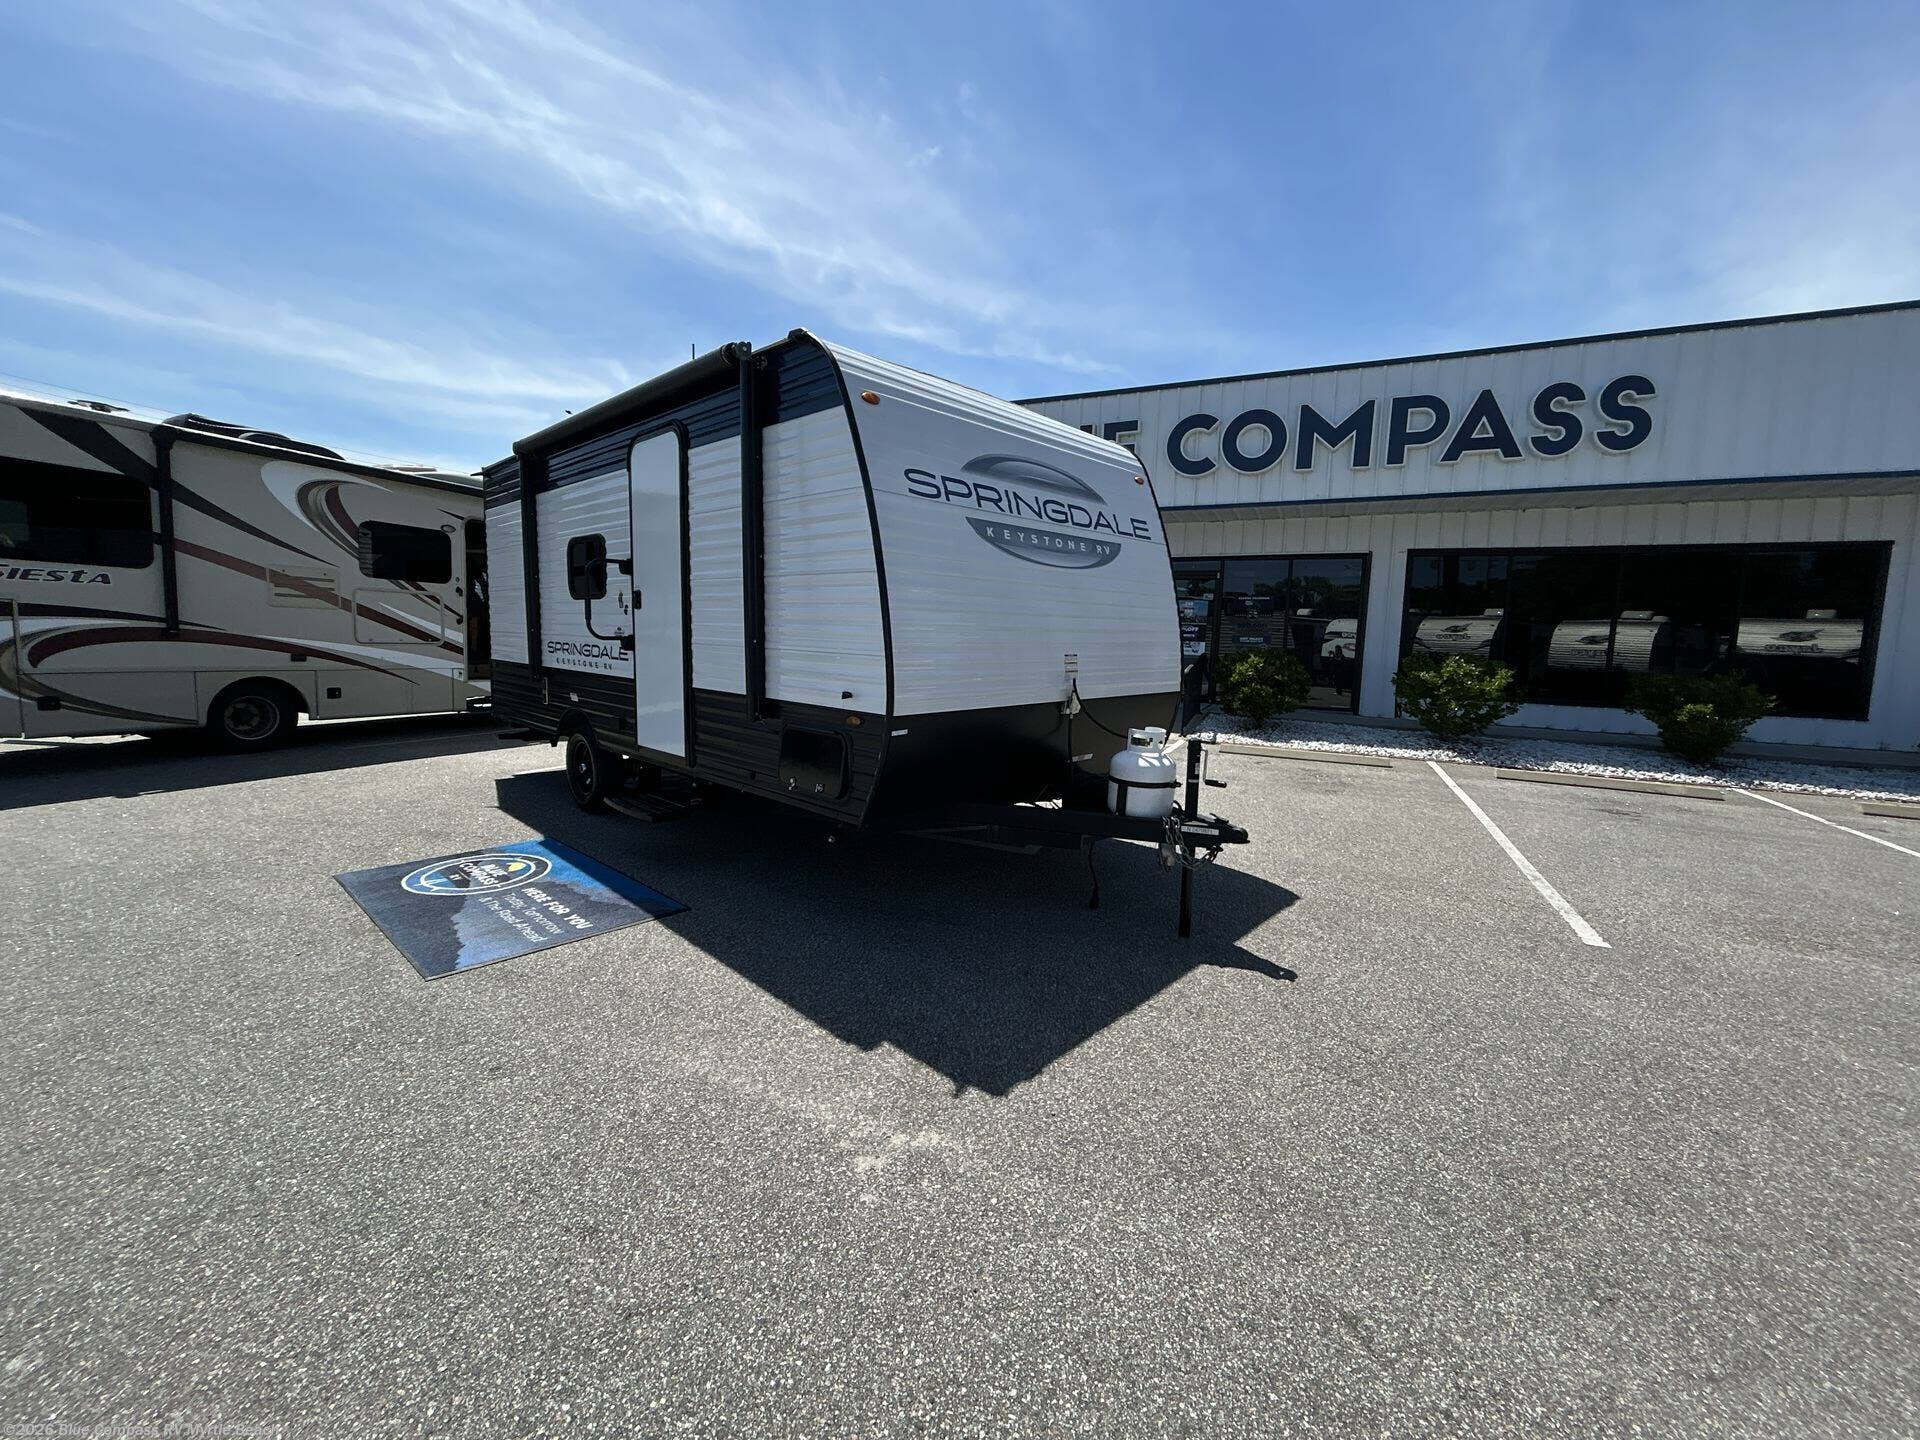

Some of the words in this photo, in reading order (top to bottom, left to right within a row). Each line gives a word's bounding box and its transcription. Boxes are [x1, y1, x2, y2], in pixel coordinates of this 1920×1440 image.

[1167, 375, 1656, 476] COMPASS
[904, 468, 1152, 541] SPRINGDALE
[986, 526, 1086, 552] KEYSTONE
[1096, 544, 1110, 555] RV
[547, 641, 629, 661] SPRINGDALE
[556, 657, 599, 669] KEYSTONE
[459, 863, 500, 885] COMPASS
[521, 887, 552, 902] HERE
[543, 901, 571, 915] FOR
[563, 914, 594, 929] YOU
